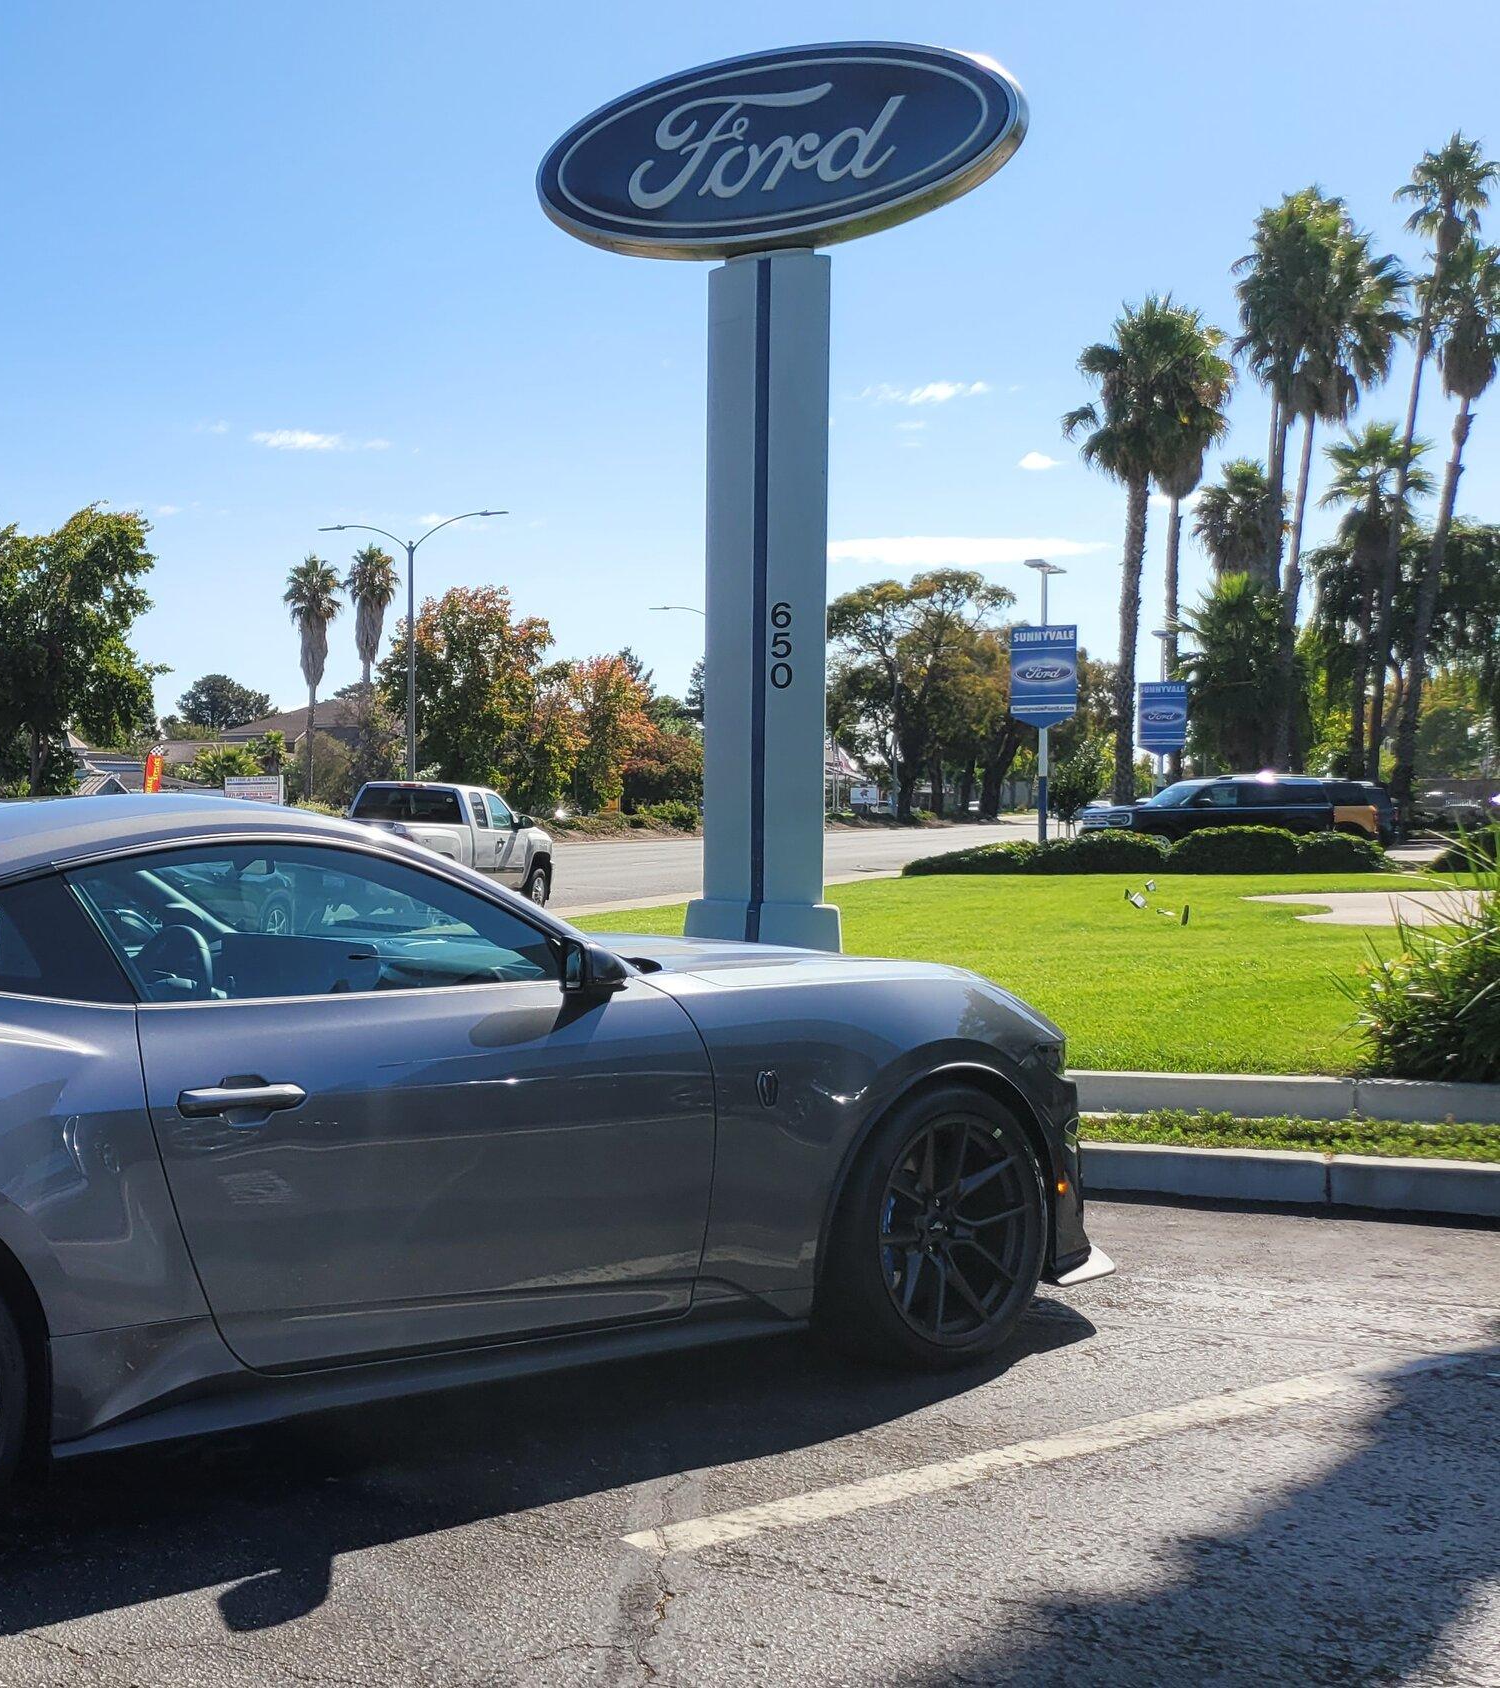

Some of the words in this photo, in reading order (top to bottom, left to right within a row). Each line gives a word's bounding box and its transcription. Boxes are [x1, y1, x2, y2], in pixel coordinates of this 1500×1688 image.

[628, 82, 907, 209] Ford
[1013, 630, 1075, 643] SUNNYVALE
[770, 602, 793, 689] 650
[1025, 665, 1061, 679] Ford
[1140, 685, 1186, 693] SUNNYVALE
[1148, 711, 1175, 720] Ford
